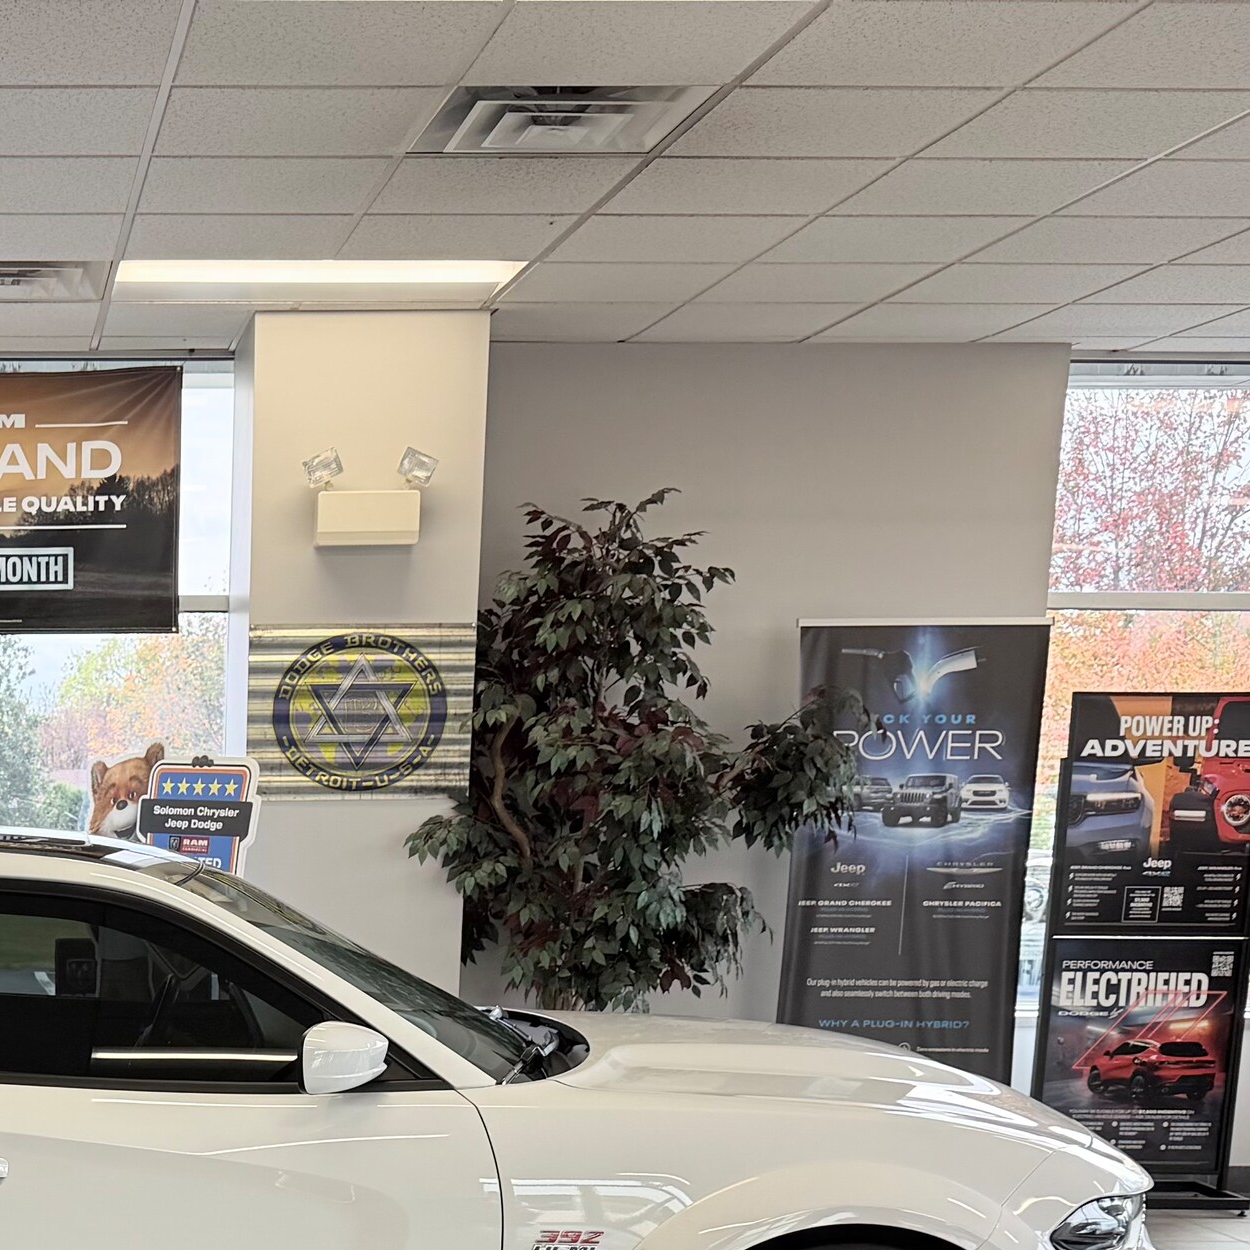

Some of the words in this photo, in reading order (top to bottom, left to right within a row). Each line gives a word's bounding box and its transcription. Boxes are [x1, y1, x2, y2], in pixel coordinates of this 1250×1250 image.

[21, 494, 128, 514] QUALITY
[278, 640, 336, 701] DODGE
[344, 633, 442, 695] BROTHERS
[922, 713, 977, 724] YOUR
[1120, 715, 1186, 737] POWER
[1188, 715, 1220, 737] UP:
[833, 728, 1006, 761] POWER
[153, 805, 195, 817] Solomon
[196, 806, 240, 819] Chrysler
[165, 818, 189, 830] Jeep
[190, 819, 223, 831] Dodge
[182, 838, 209, 847] RAM
[830, 862, 867, 876] Jeep
[1143, 857, 1172, 871] Jeep
[1062, 960, 1154, 970] PERFORMANCE
[1058, 970, 1210, 1008] ELECTRIFIED
[818, 1019, 848, 1028] WHY
[850, 1020, 860, 1028] A
[862, 1019, 913, 1029] PLUG-IN
[915, 1020, 970, 1030] HYBRID?
[535, 1230, 605, 1244] 392
